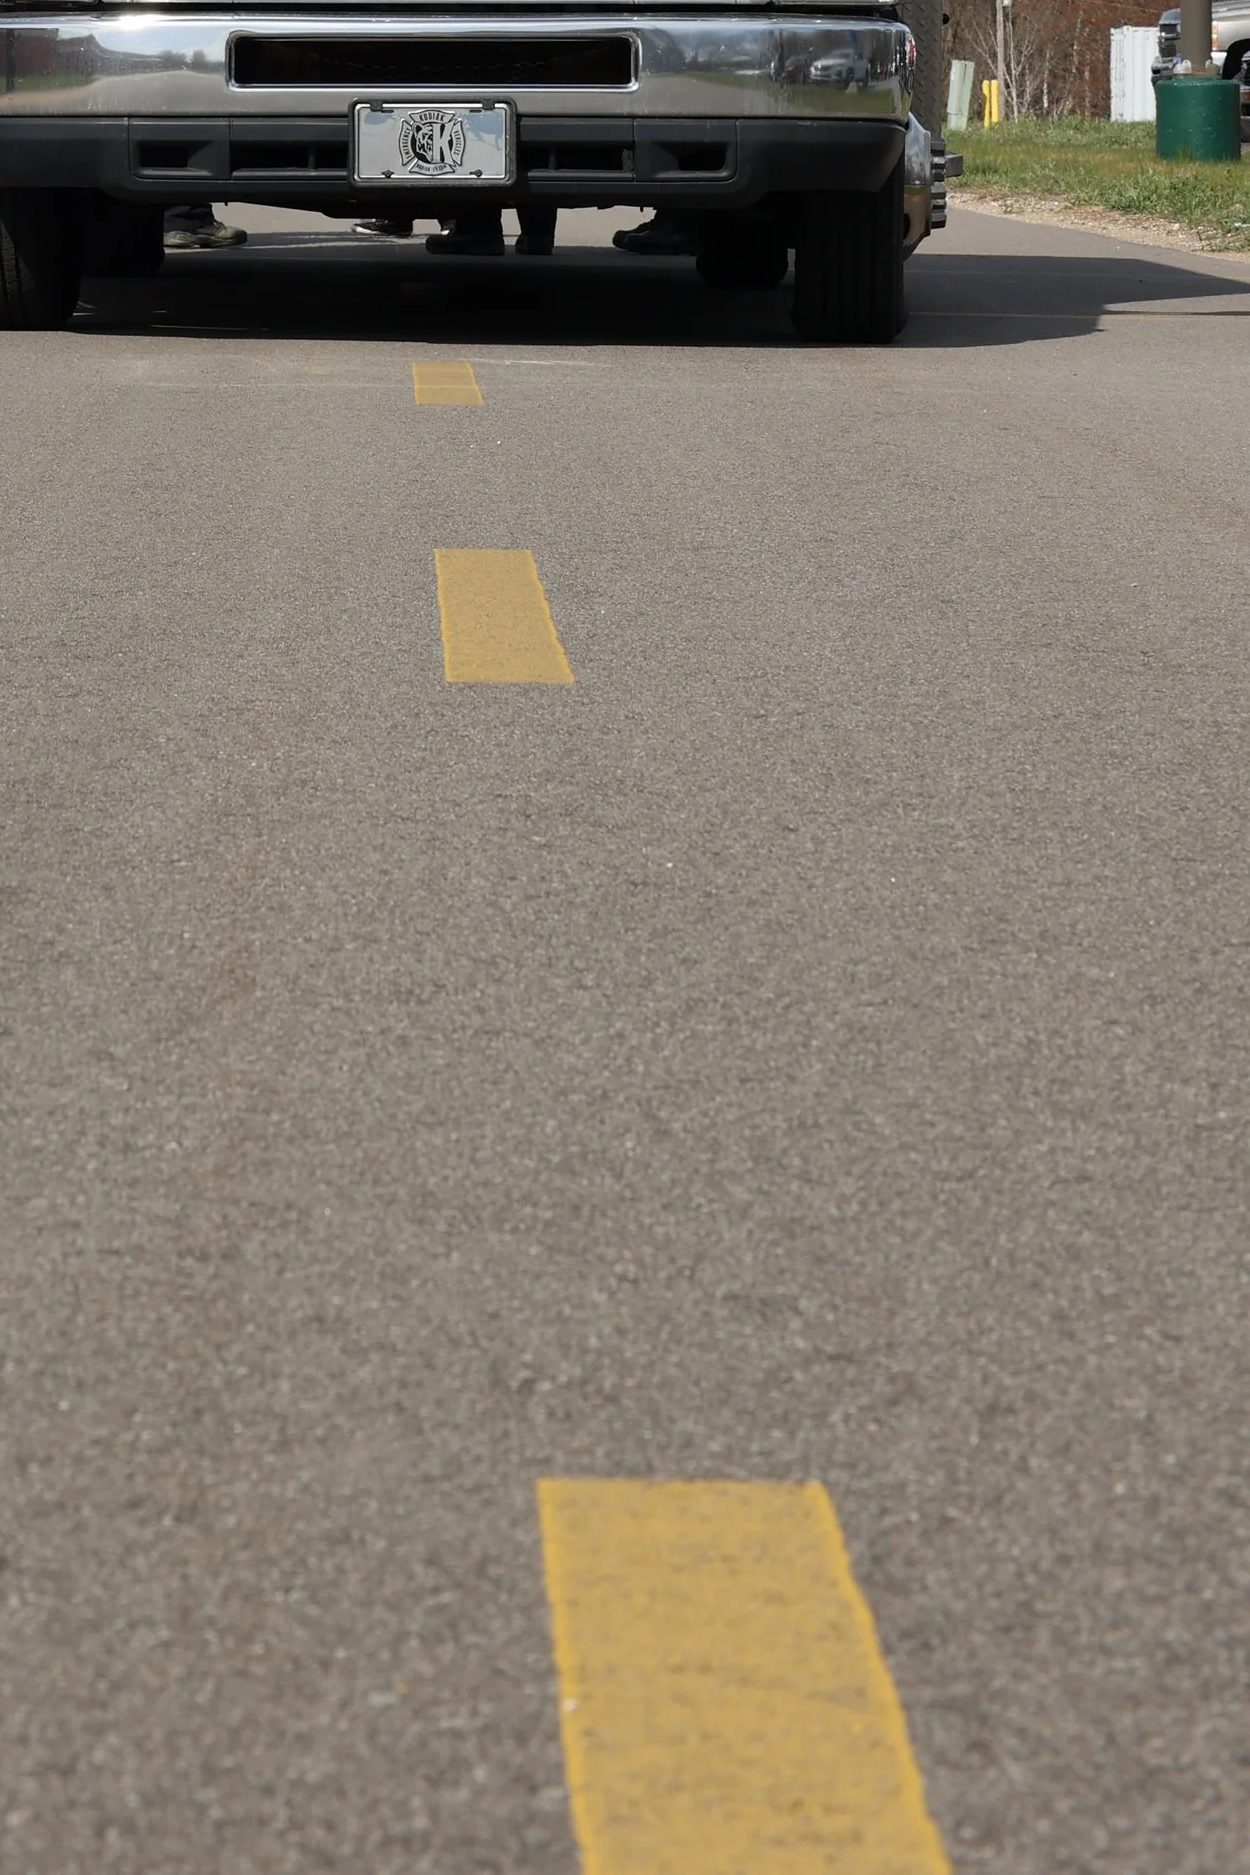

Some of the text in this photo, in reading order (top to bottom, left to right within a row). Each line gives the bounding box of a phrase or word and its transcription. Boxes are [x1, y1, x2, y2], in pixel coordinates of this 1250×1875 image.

[419, 112, 446, 122] KODIAK
[402, 127, 412, 159] EMERGENCY
[432, 120, 455, 166] K
[453, 130, 462, 156] VEHICLES
